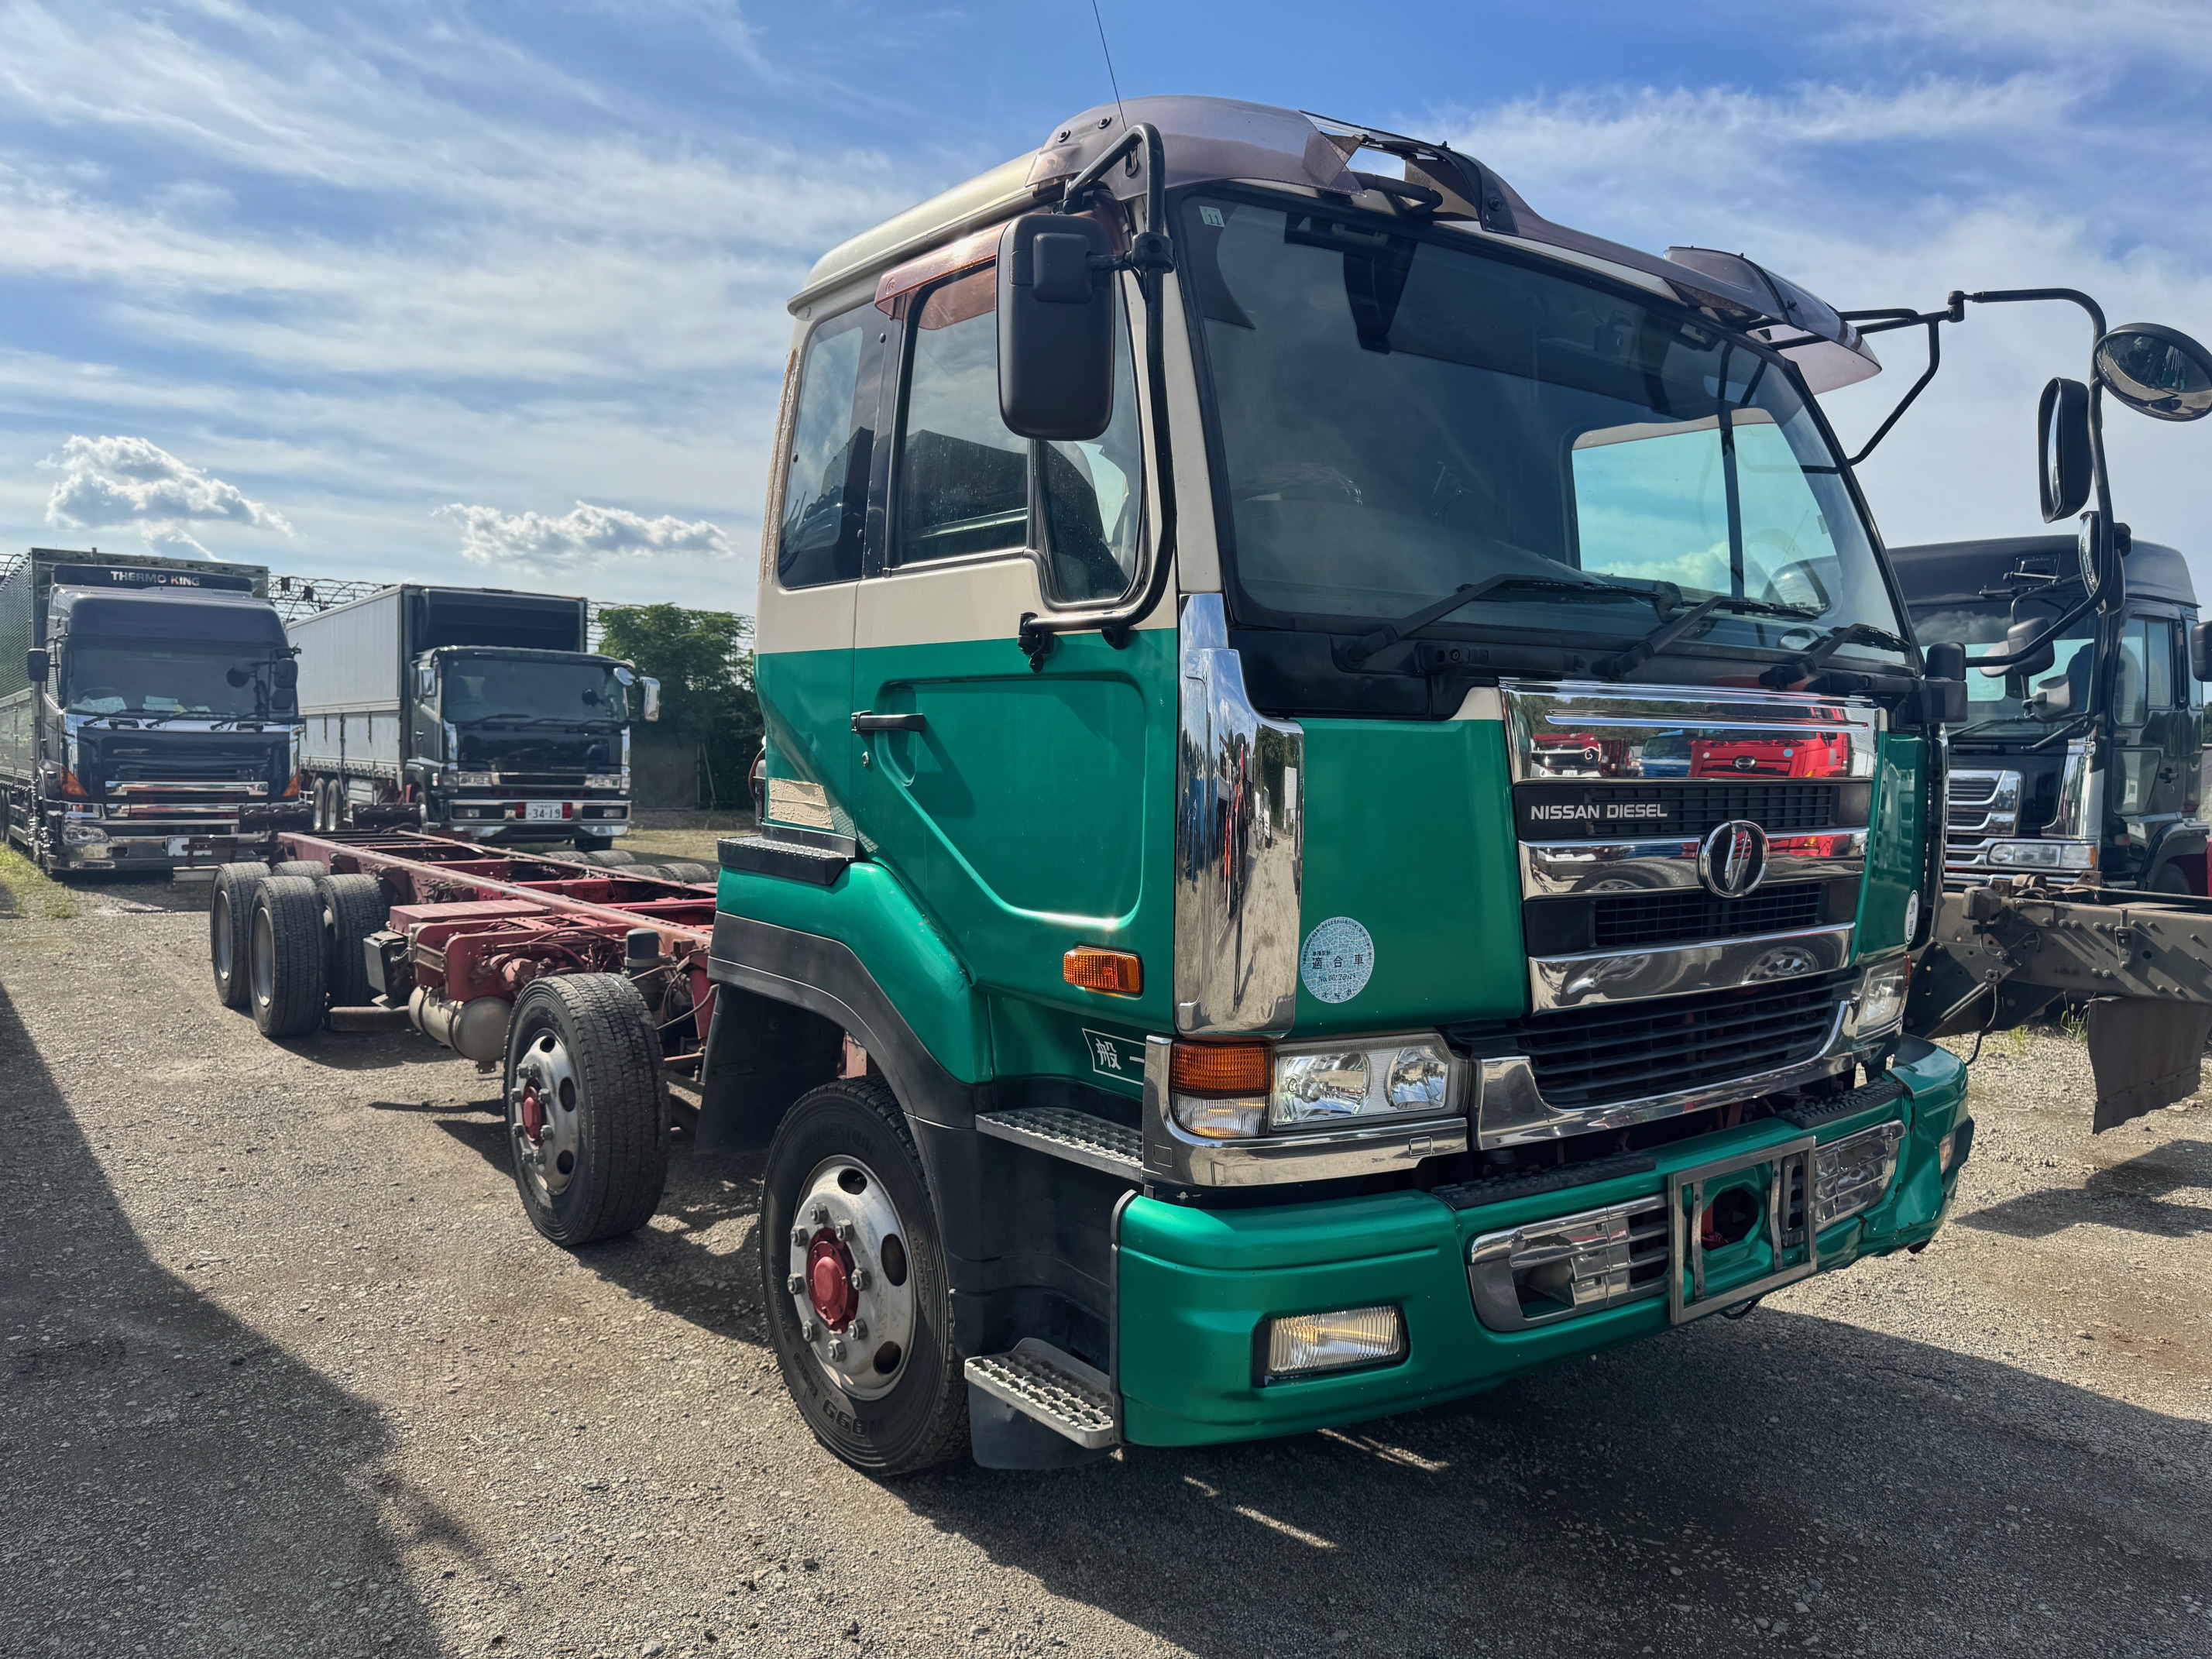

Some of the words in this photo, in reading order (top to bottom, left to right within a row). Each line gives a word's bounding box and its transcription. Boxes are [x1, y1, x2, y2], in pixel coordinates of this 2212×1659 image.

[111, 571, 167, 584] THERMO
[170, 575, 200, 586] KING
[1530, 805, 1600, 820] NISSAN
[1606, 804, 1668, 819] DIESEL
[1312, 953, 1363, 970] 適合車
